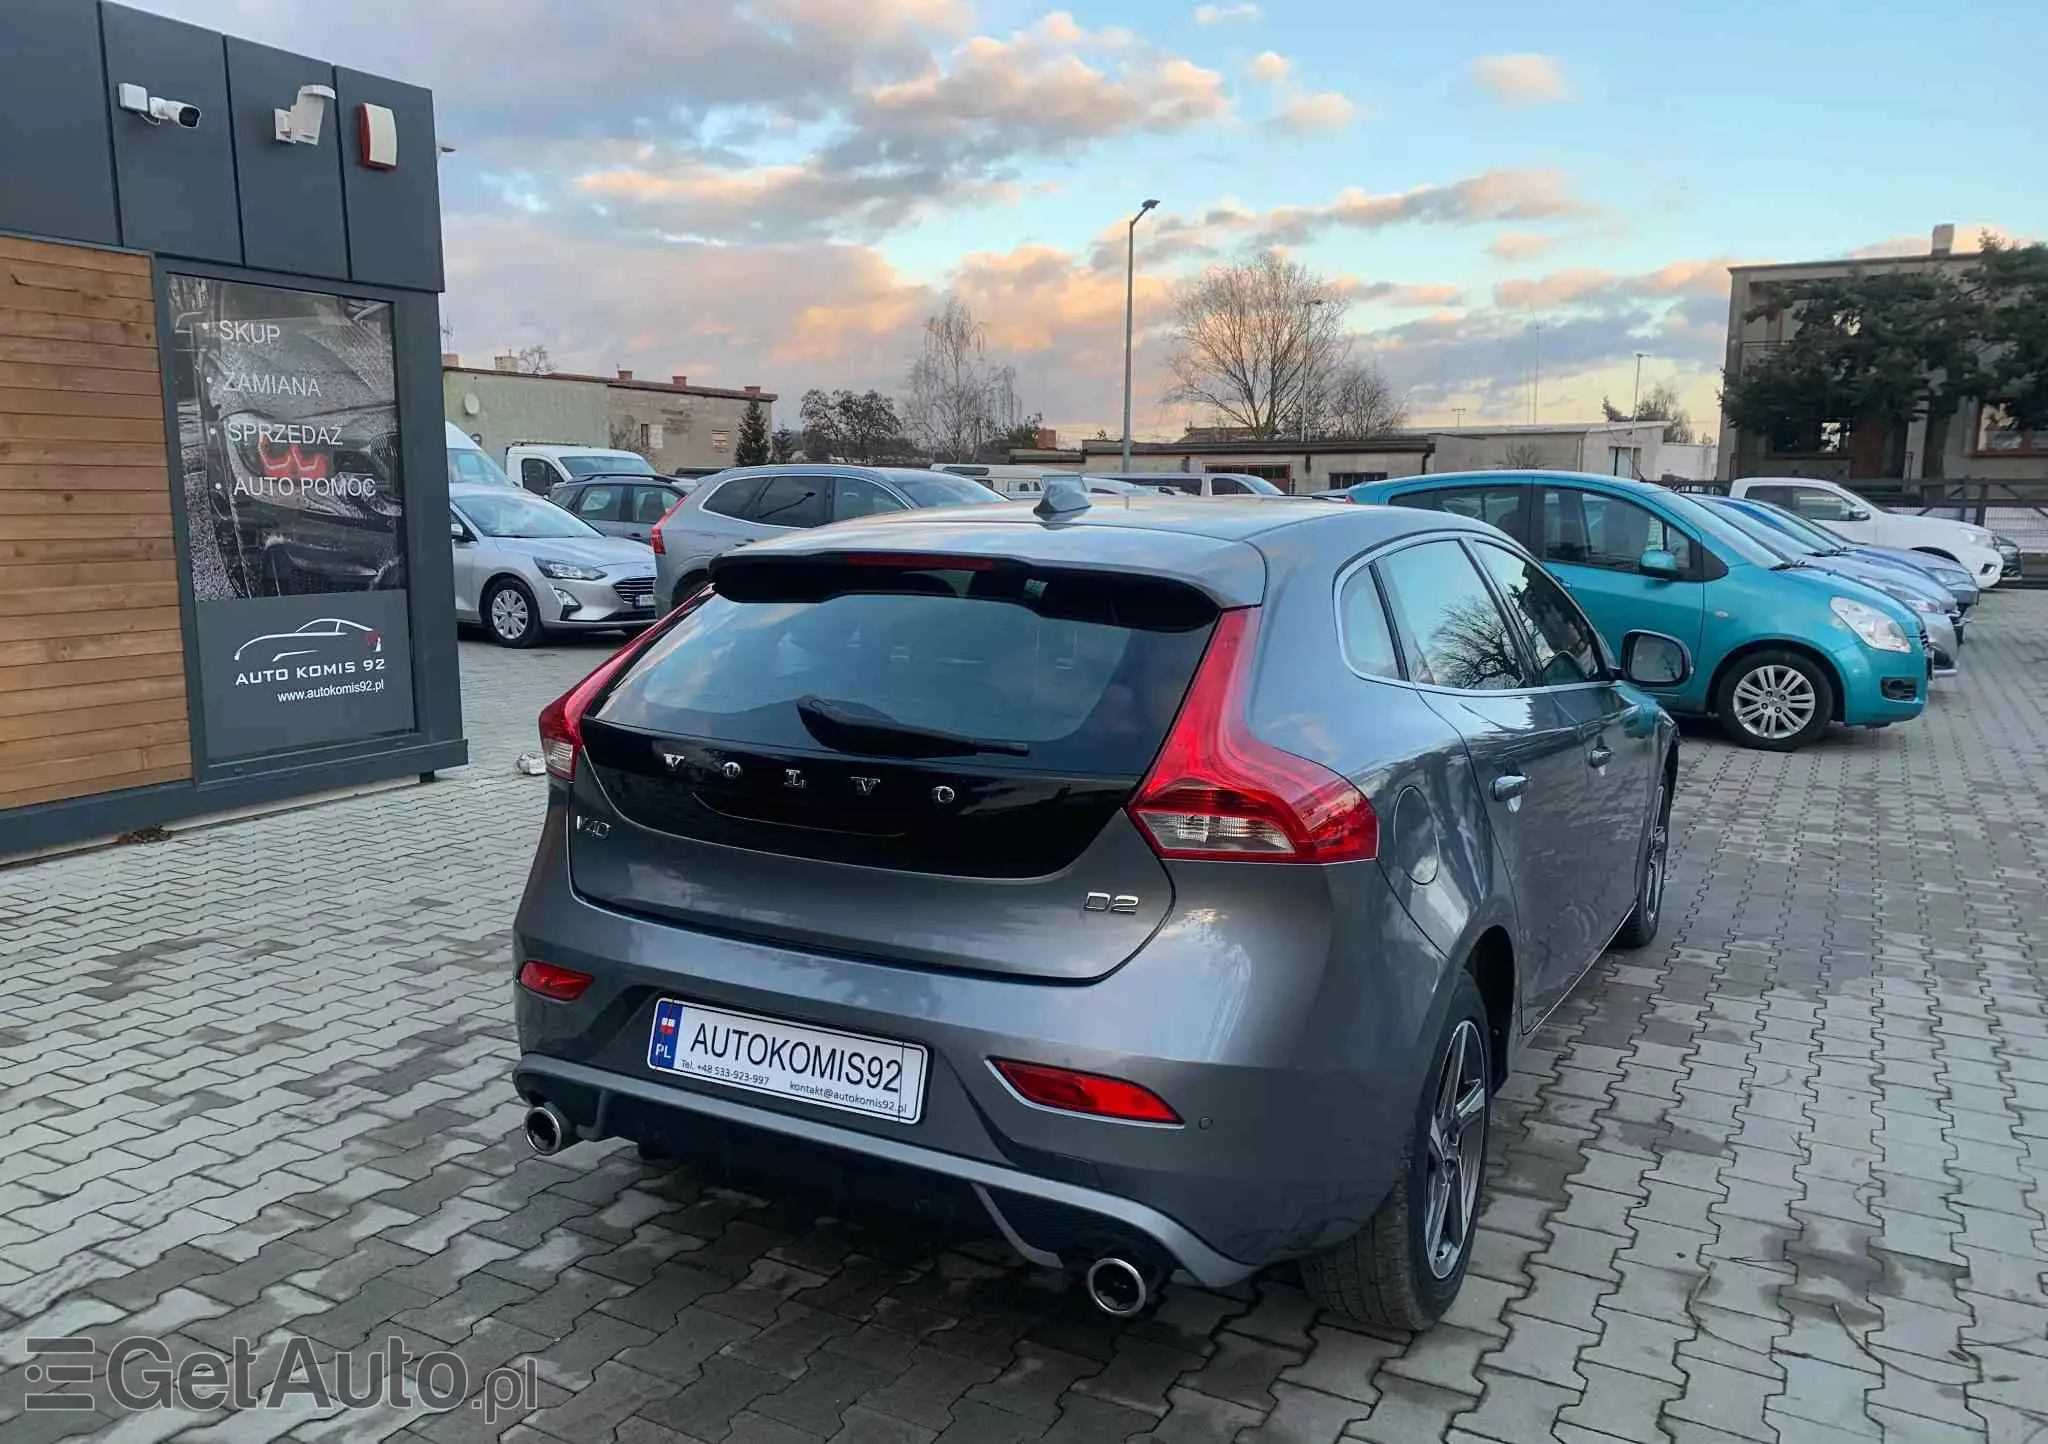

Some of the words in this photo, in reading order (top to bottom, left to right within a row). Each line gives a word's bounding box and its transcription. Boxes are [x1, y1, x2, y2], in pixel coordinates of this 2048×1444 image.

[219, 320, 280, 344] SKUP
[223, 371, 322, 397] ZAMIANA
[233, 477, 294, 496] AUTO
[301, 478, 376, 498] POMOC
[235, 669, 288, 685] AUTO
[296, 662, 356, 678] KOMIS
[363, 658, 385, 671] 92
[277, 678, 384, 702] www.autokomis92.pl
[663, 753, 955, 803] VOLVO
[1083, 892, 1139, 914] D2
[655, 1043, 671, 1059] PL
[690, 1023, 902, 1093] AUTOKOMIS92
[789, 1080, 908, 1113] kontakt@autokomis92.pl
